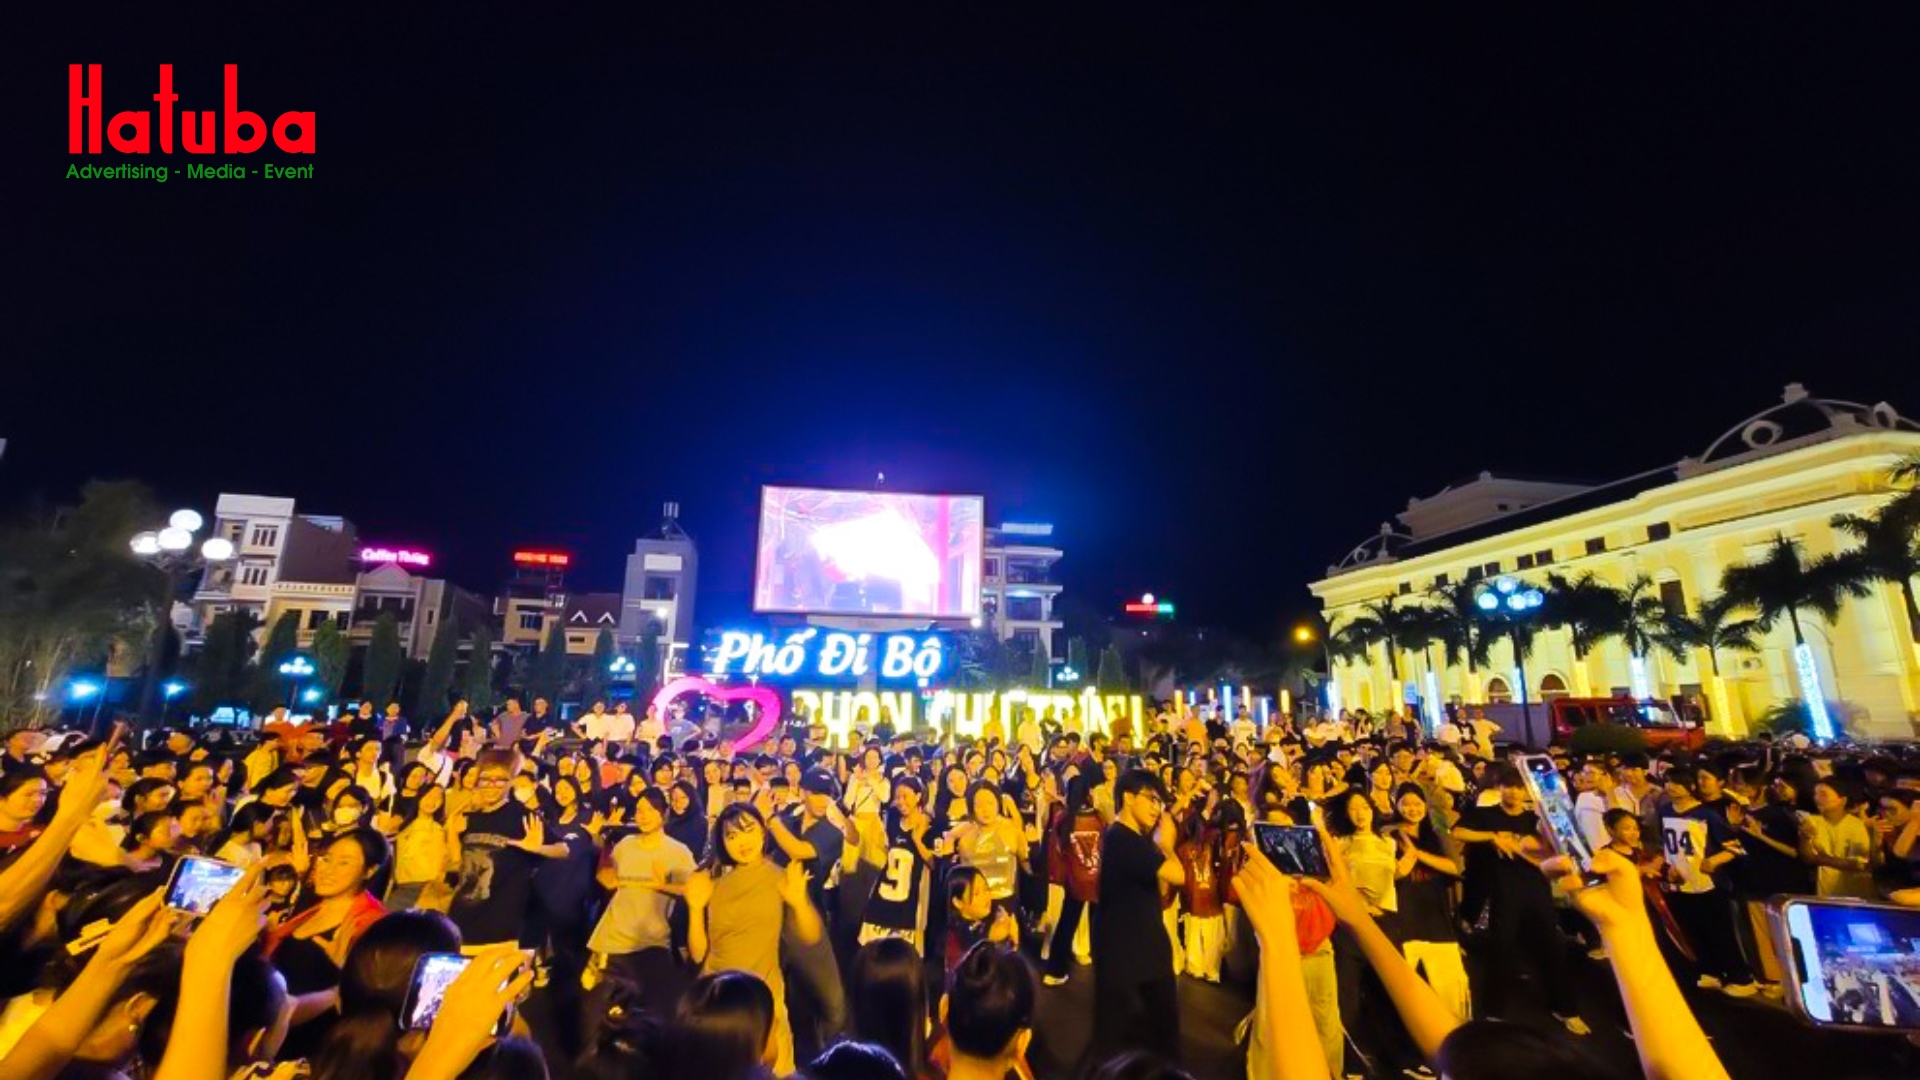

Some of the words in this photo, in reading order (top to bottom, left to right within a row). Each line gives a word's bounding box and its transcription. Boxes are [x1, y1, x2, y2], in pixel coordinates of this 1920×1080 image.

[712, 628, 817, 675] Phố
[818, 633, 871, 675] Đi
[882, 635, 941, 687] Bộ
[1663, 829, 1694, 855] 04
[878, 847, 914, 902] 9
